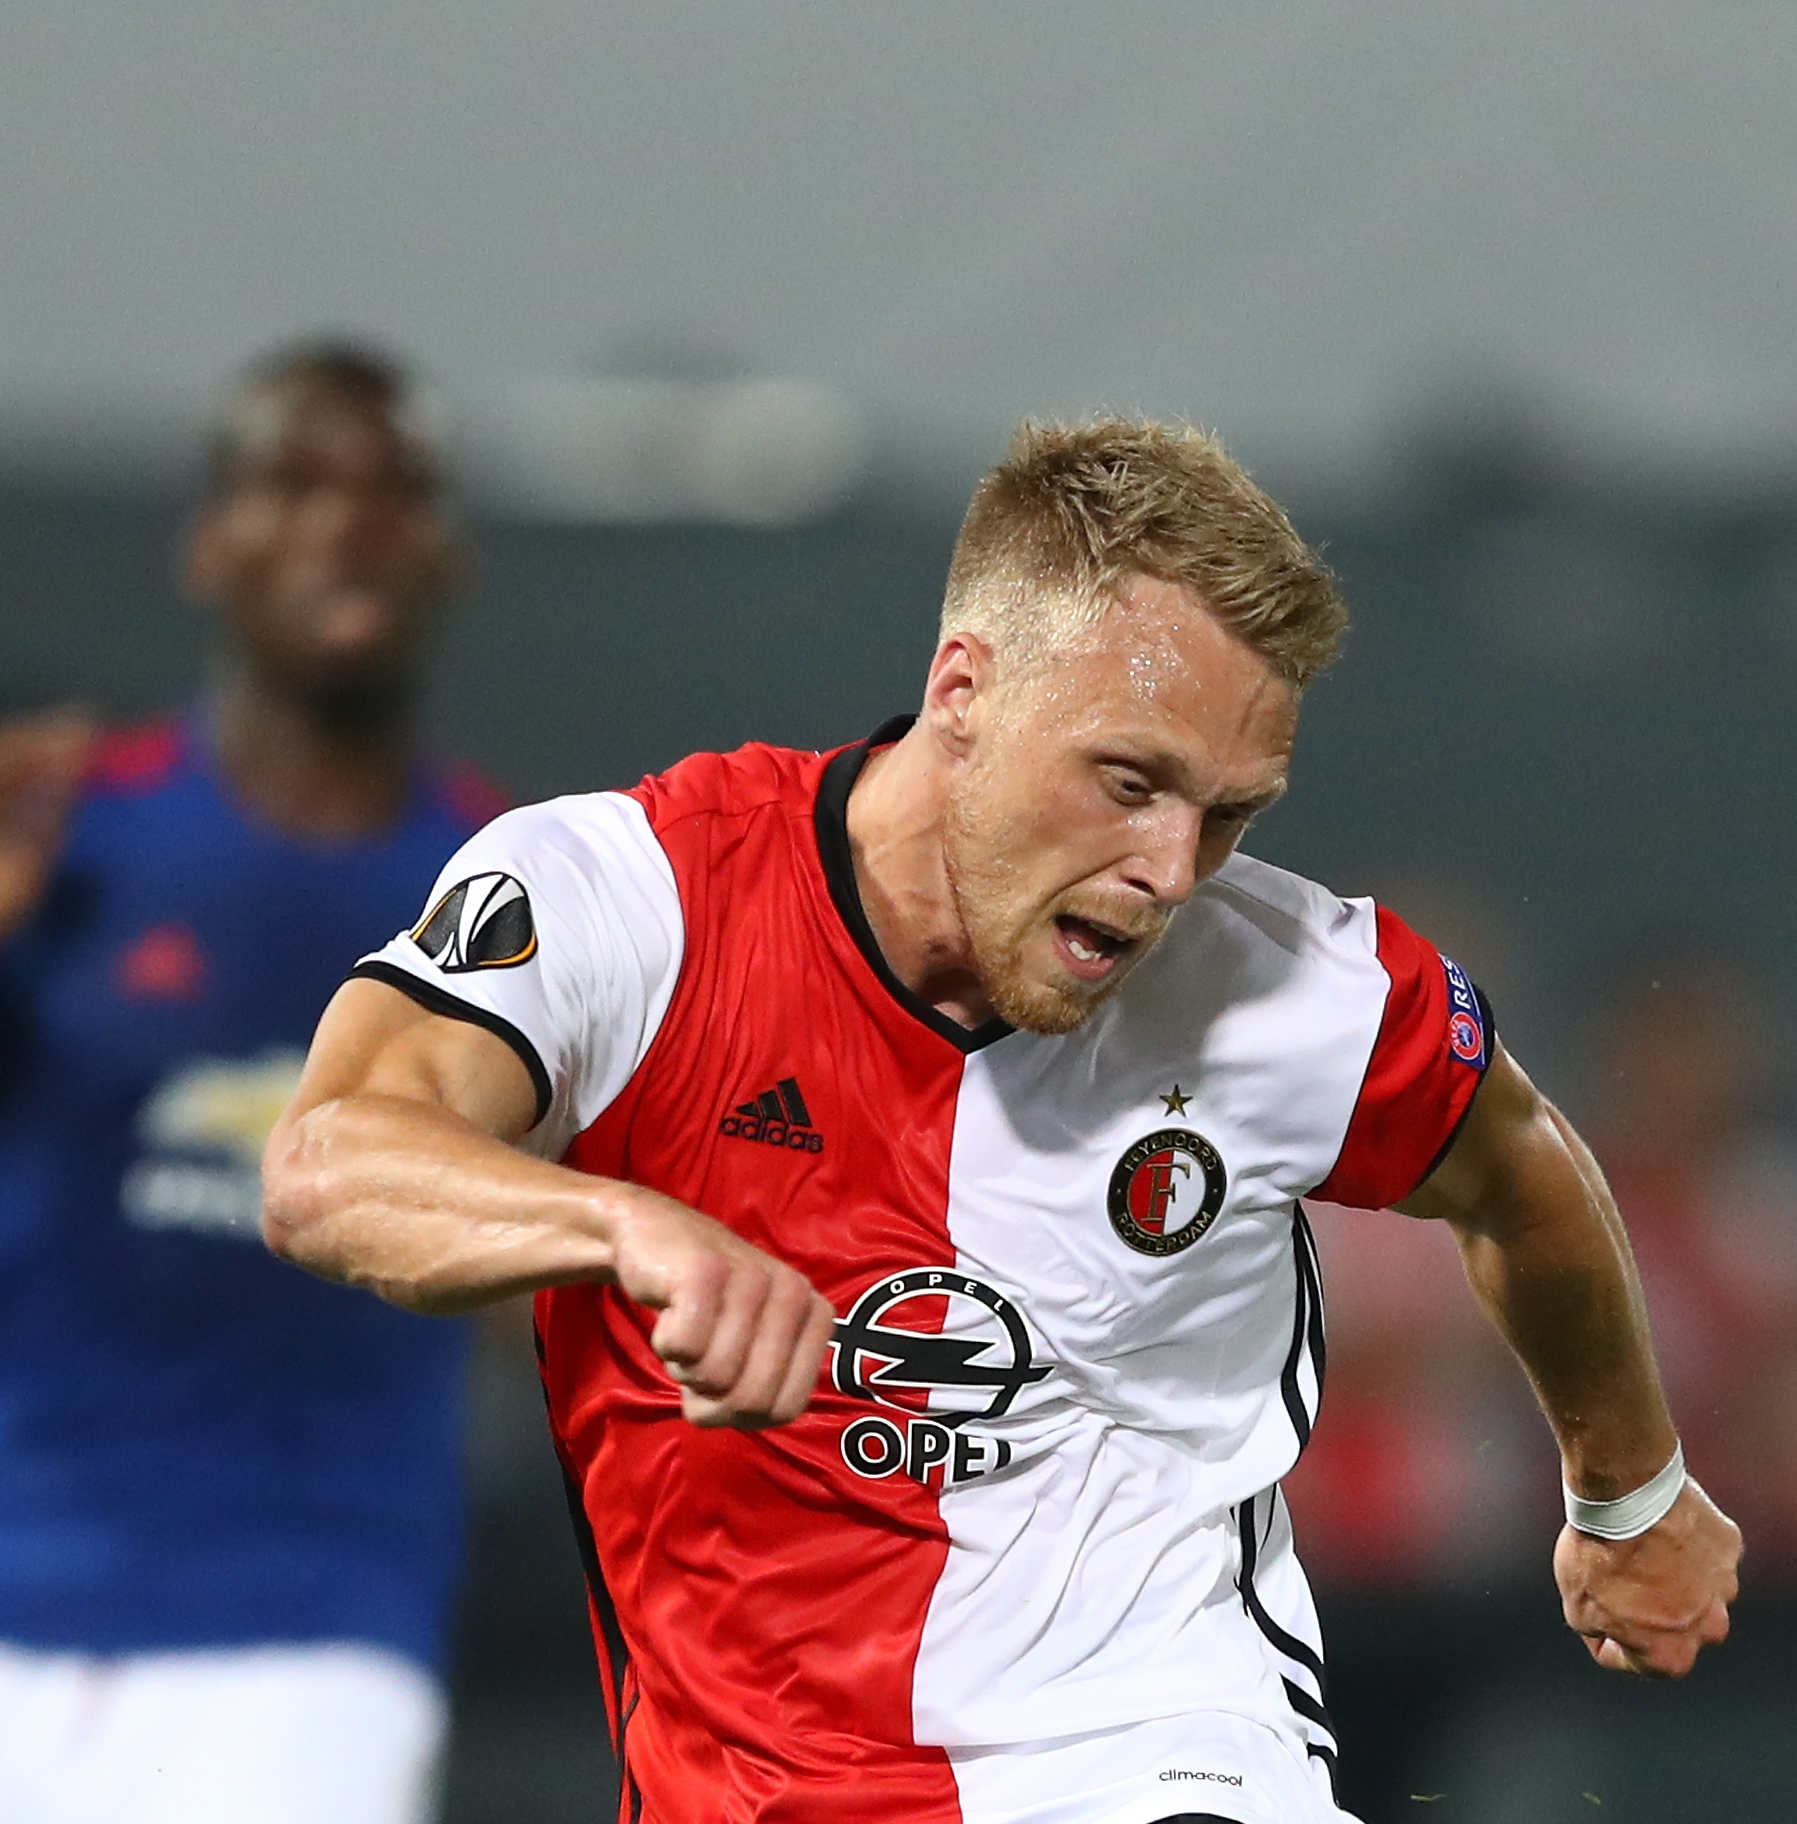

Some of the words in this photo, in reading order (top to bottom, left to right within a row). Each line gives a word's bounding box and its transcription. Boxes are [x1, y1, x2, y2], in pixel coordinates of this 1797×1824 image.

[720, 1118, 823, 1154] adidas
[1123, 1133, 1217, 1171] FEYENOORD
[1114, 1210, 1212, 1252] ROTTERDAM
[890, 1273, 1003, 1312] OPEL
[1159, 1769, 1242, 1787] climacool
